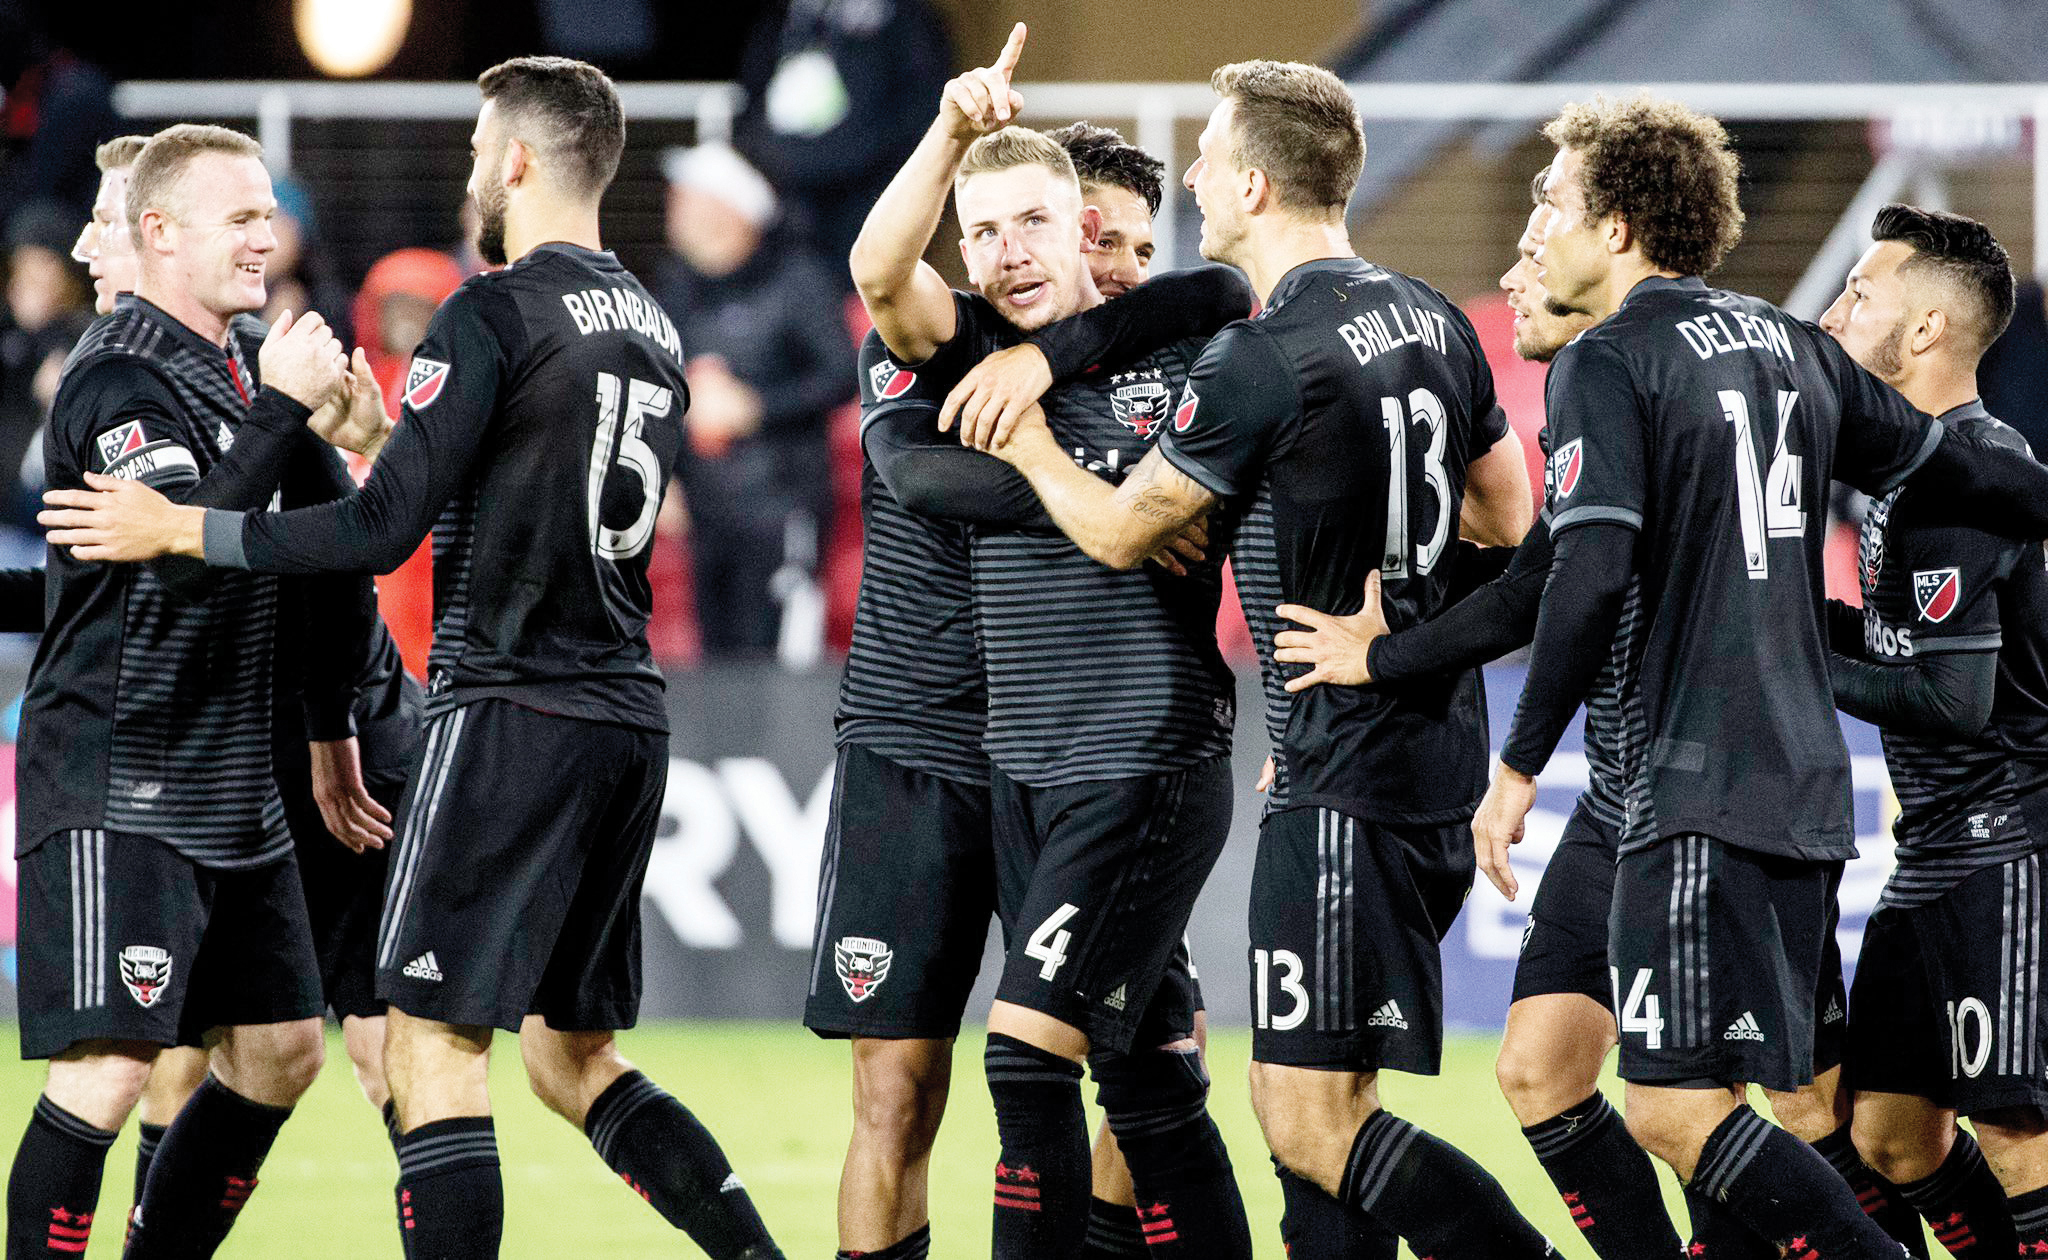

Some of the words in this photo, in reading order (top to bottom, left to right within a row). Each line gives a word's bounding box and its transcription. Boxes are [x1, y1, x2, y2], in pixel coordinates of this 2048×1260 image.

[562, 287, 682, 366] BIRNBAUM
[1337, 302, 1447, 366] BRILLANT
[1675, 310, 1795, 361] DELEON
[101, 430, 125, 449] MLS
[588, 371, 673, 560] 15
[1380, 387, 1452, 580] 13
[1716, 389, 1807, 580] 14
[1917, 575, 1940, 588] MLS
[403, 965, 443, 981] adidas
[1024, 902, 1080, 982] 4
[1254, 949, 1310, 1031] 13
[1823, 1008, 1844, 1024] adidas
[1367, 1015, 1409, 1030] adidas
[1723, 1028, 1765, 1042] adidas
[1946, 996, 1993, 1080] 10
